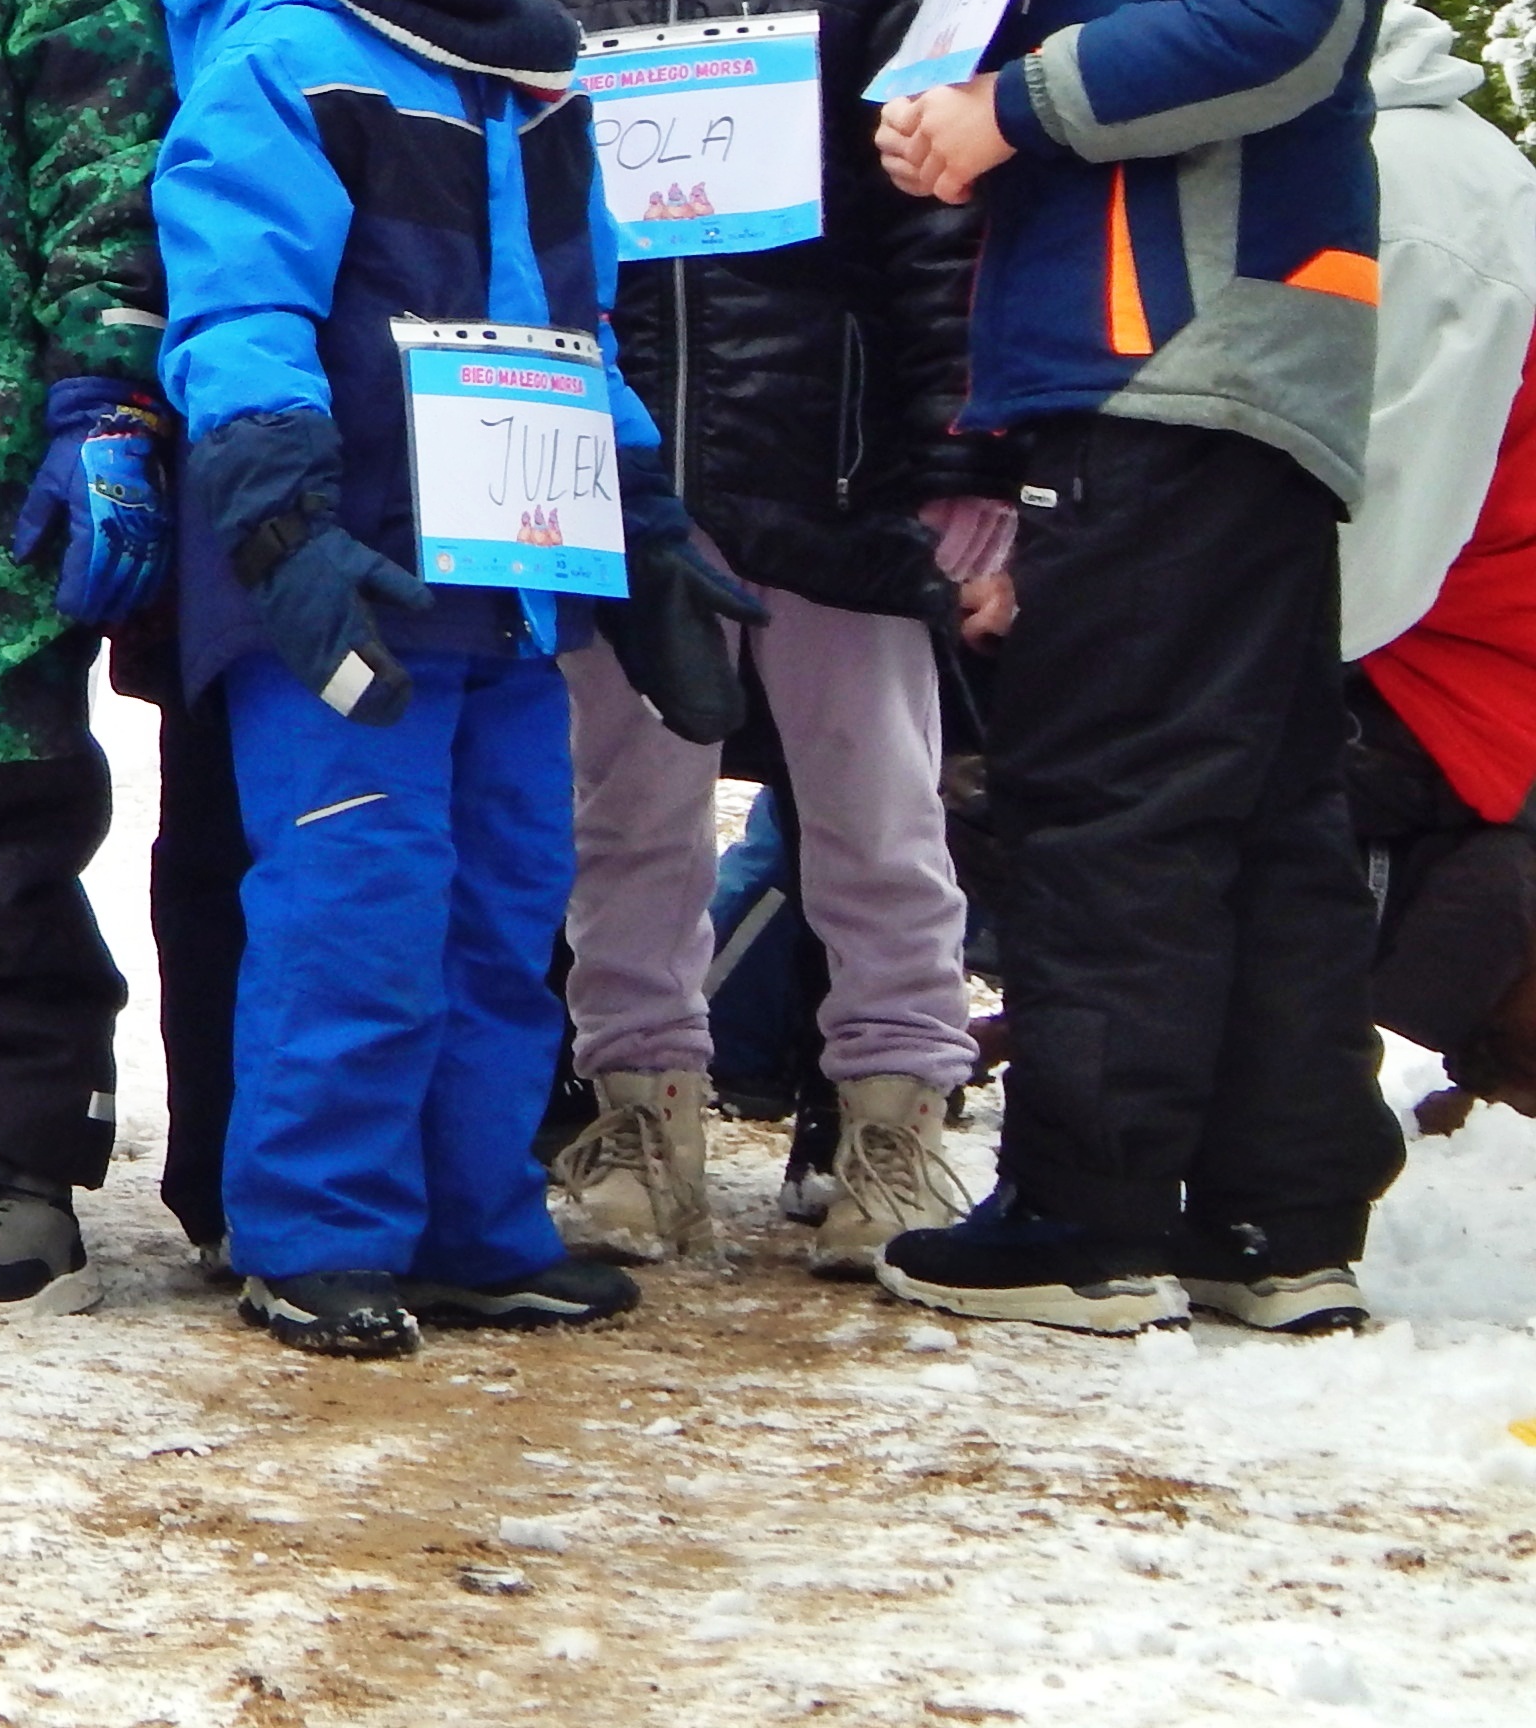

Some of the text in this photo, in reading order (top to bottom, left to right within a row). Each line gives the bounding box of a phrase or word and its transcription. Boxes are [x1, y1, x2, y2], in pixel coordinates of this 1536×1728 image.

[619, 65, 690, 88] MAŁEGO
[695, 57, 757, 80] MORSA
[594, 114, 736, 171] POLA
[460, 365, 585, 396] BIEG MAŁEGO MORSA
[479, 414, 613, 506] JULEK
